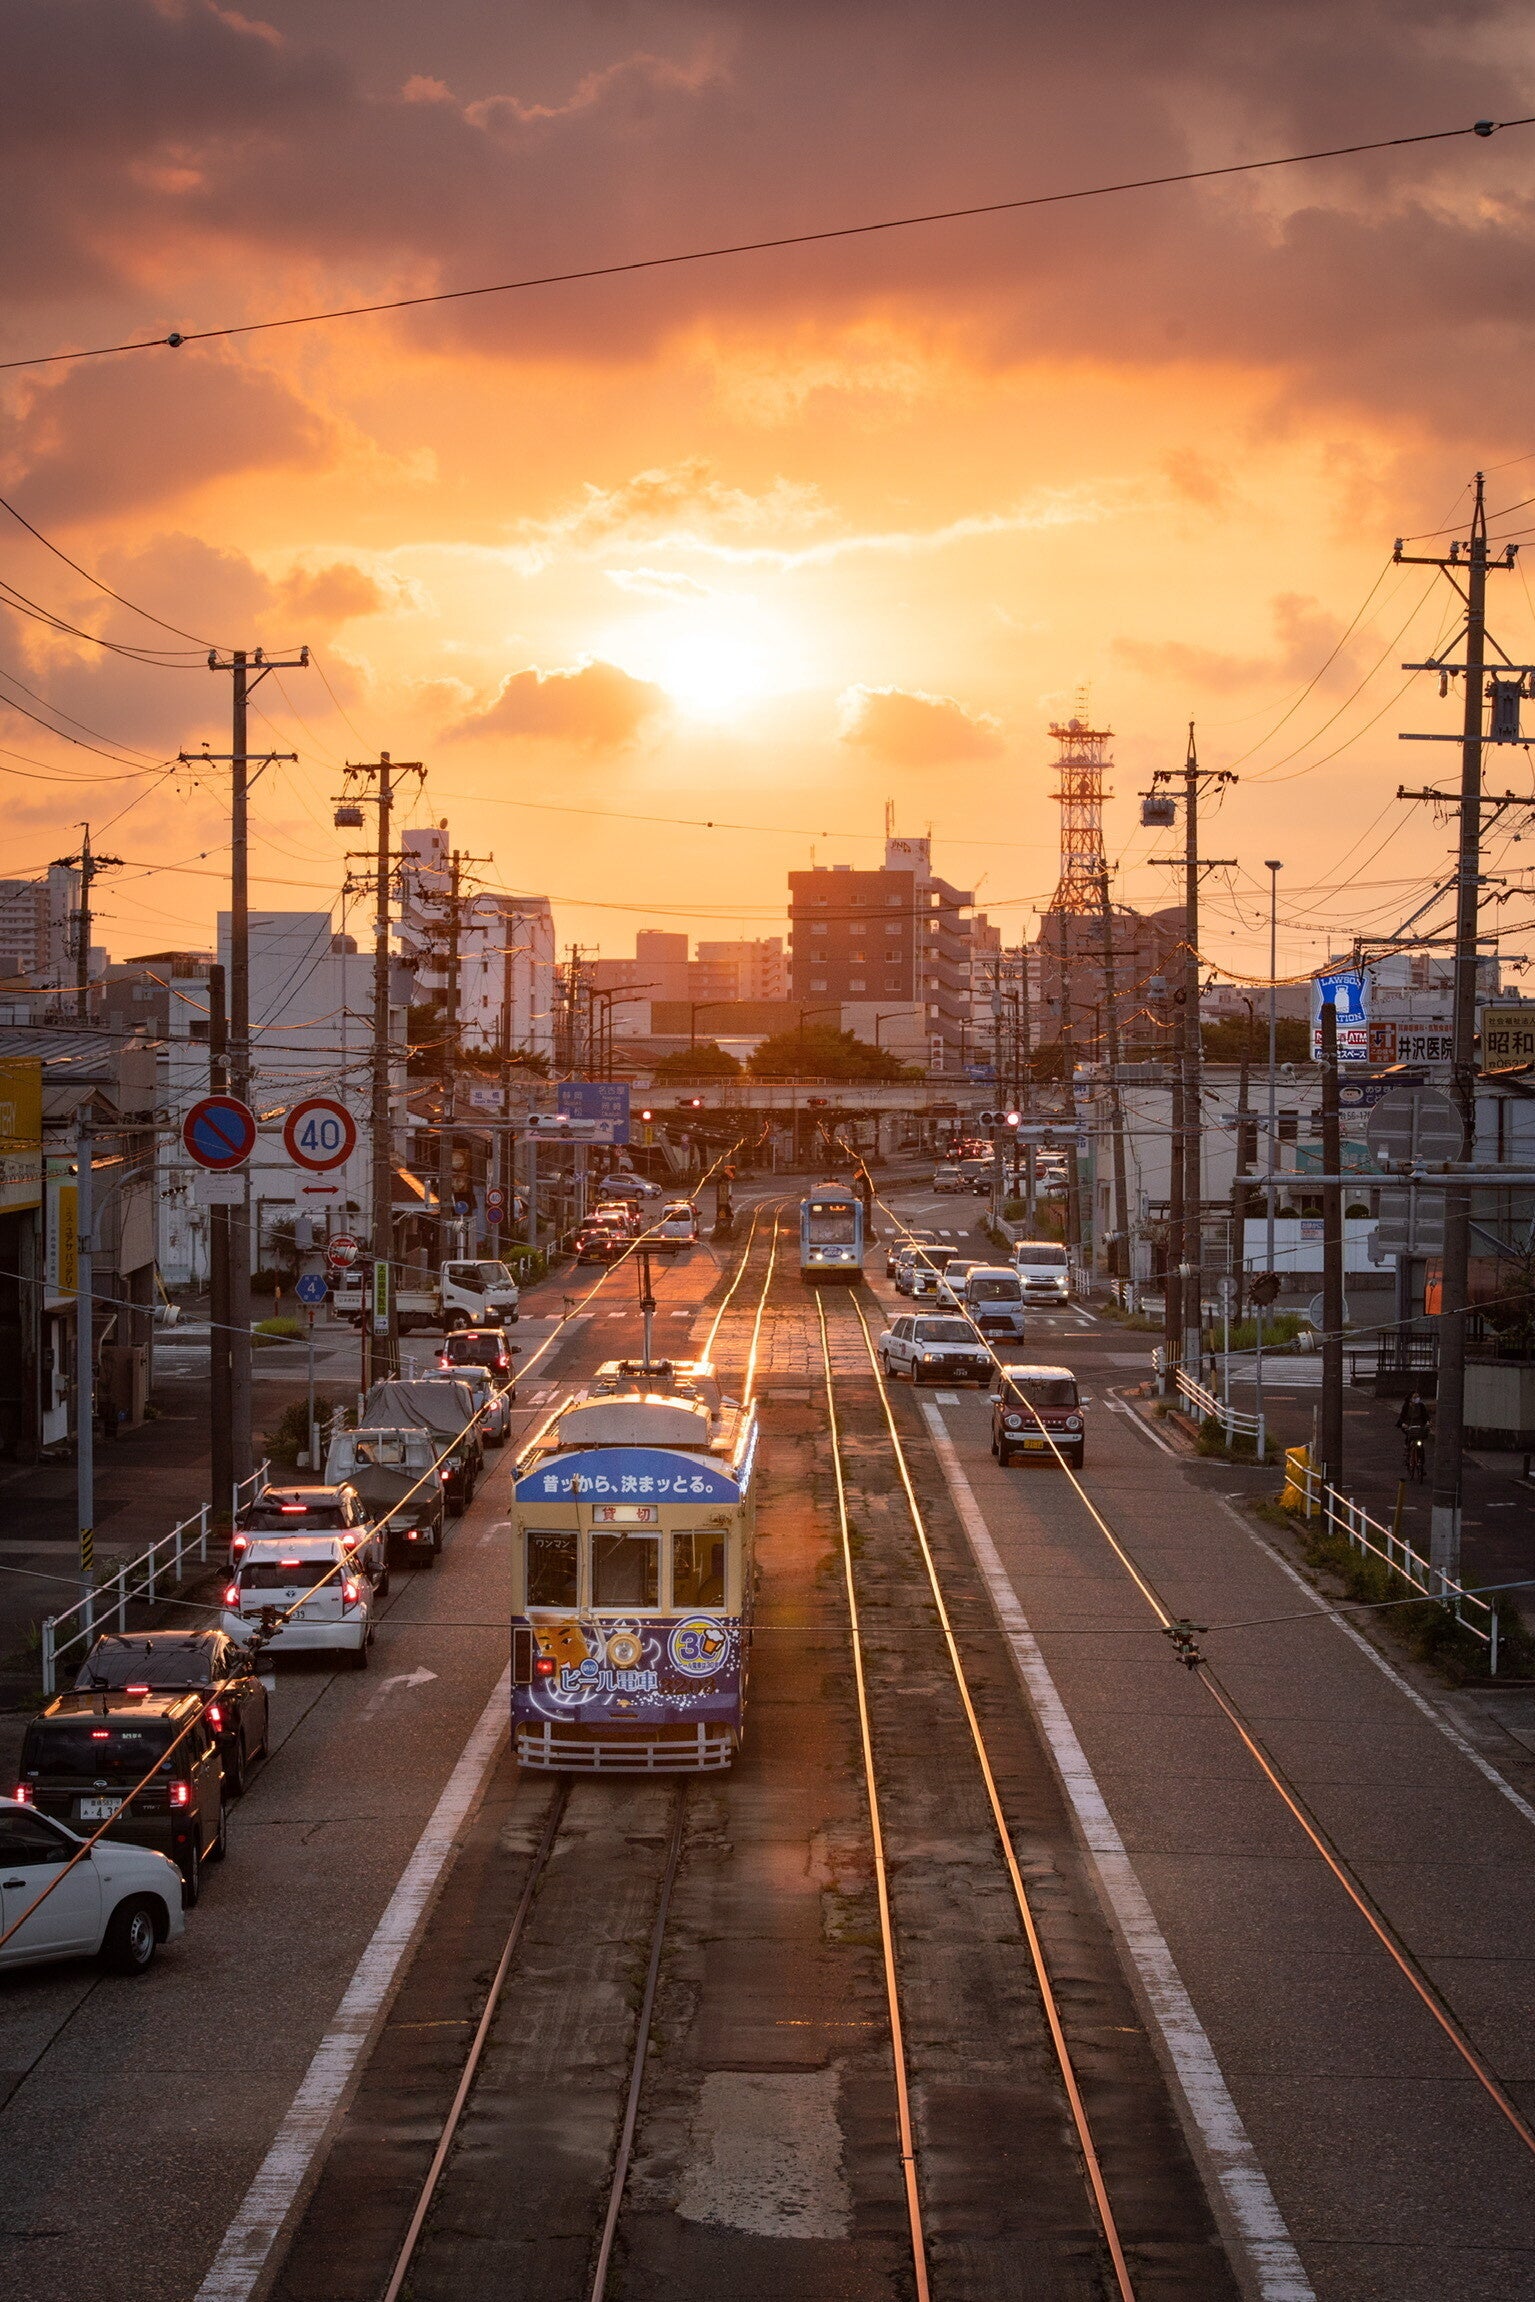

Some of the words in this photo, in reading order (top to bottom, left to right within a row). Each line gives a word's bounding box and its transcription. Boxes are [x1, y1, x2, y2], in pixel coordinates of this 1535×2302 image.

[1348, 1032, 1368, 1043] ATM
[1488, 1030, 1534, 1055] 昭和
[1398, 1035, 1453, 1061] 井沢医院
[300, 1118, 340, 1151] 40
[307, 1282, 316, 1294] 4
[602, 1507, 651, 1522] 貸切
[535, 1540, 570, 1549] ワンマン
[561, 1668, 658, 1693] ビール電車
